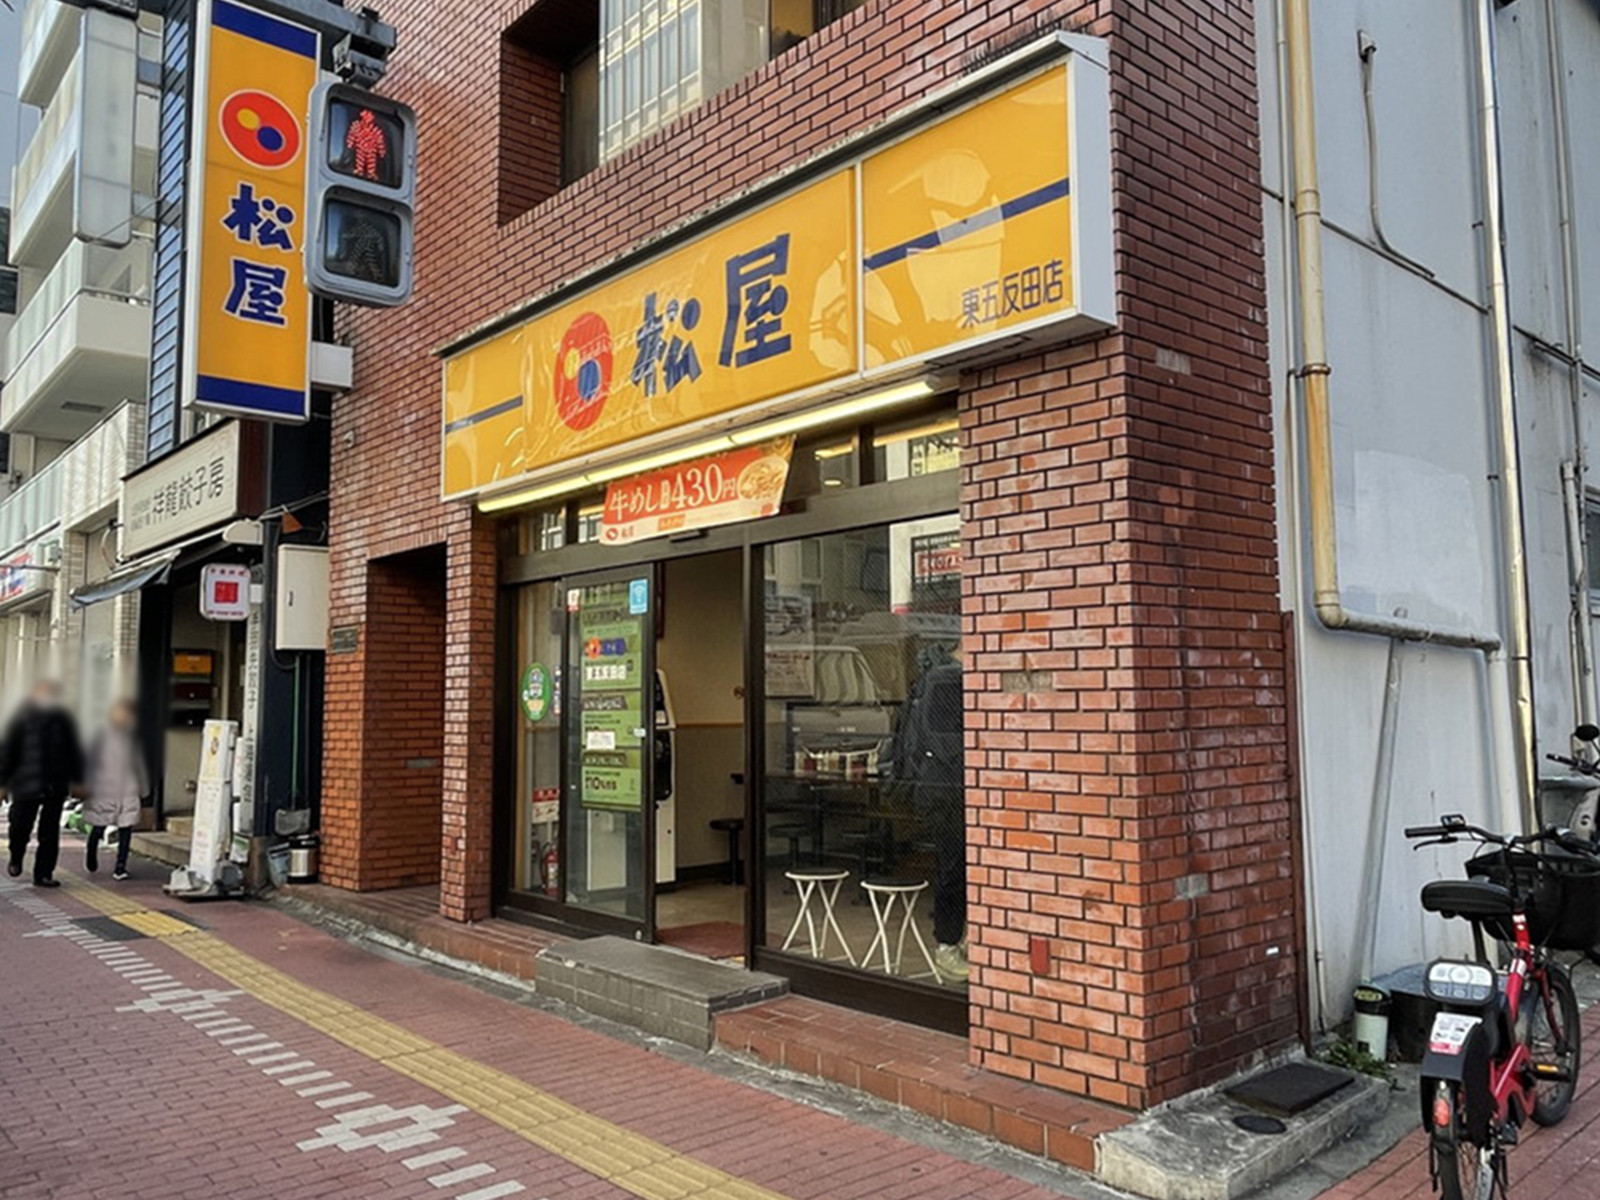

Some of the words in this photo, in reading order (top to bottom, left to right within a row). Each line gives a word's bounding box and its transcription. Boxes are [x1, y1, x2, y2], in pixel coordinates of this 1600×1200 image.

[223, 183, 294, 325] 松屋
[631, 233, 791, 398] 松屋
[961, 259, 1063, 328] 東五反田店
